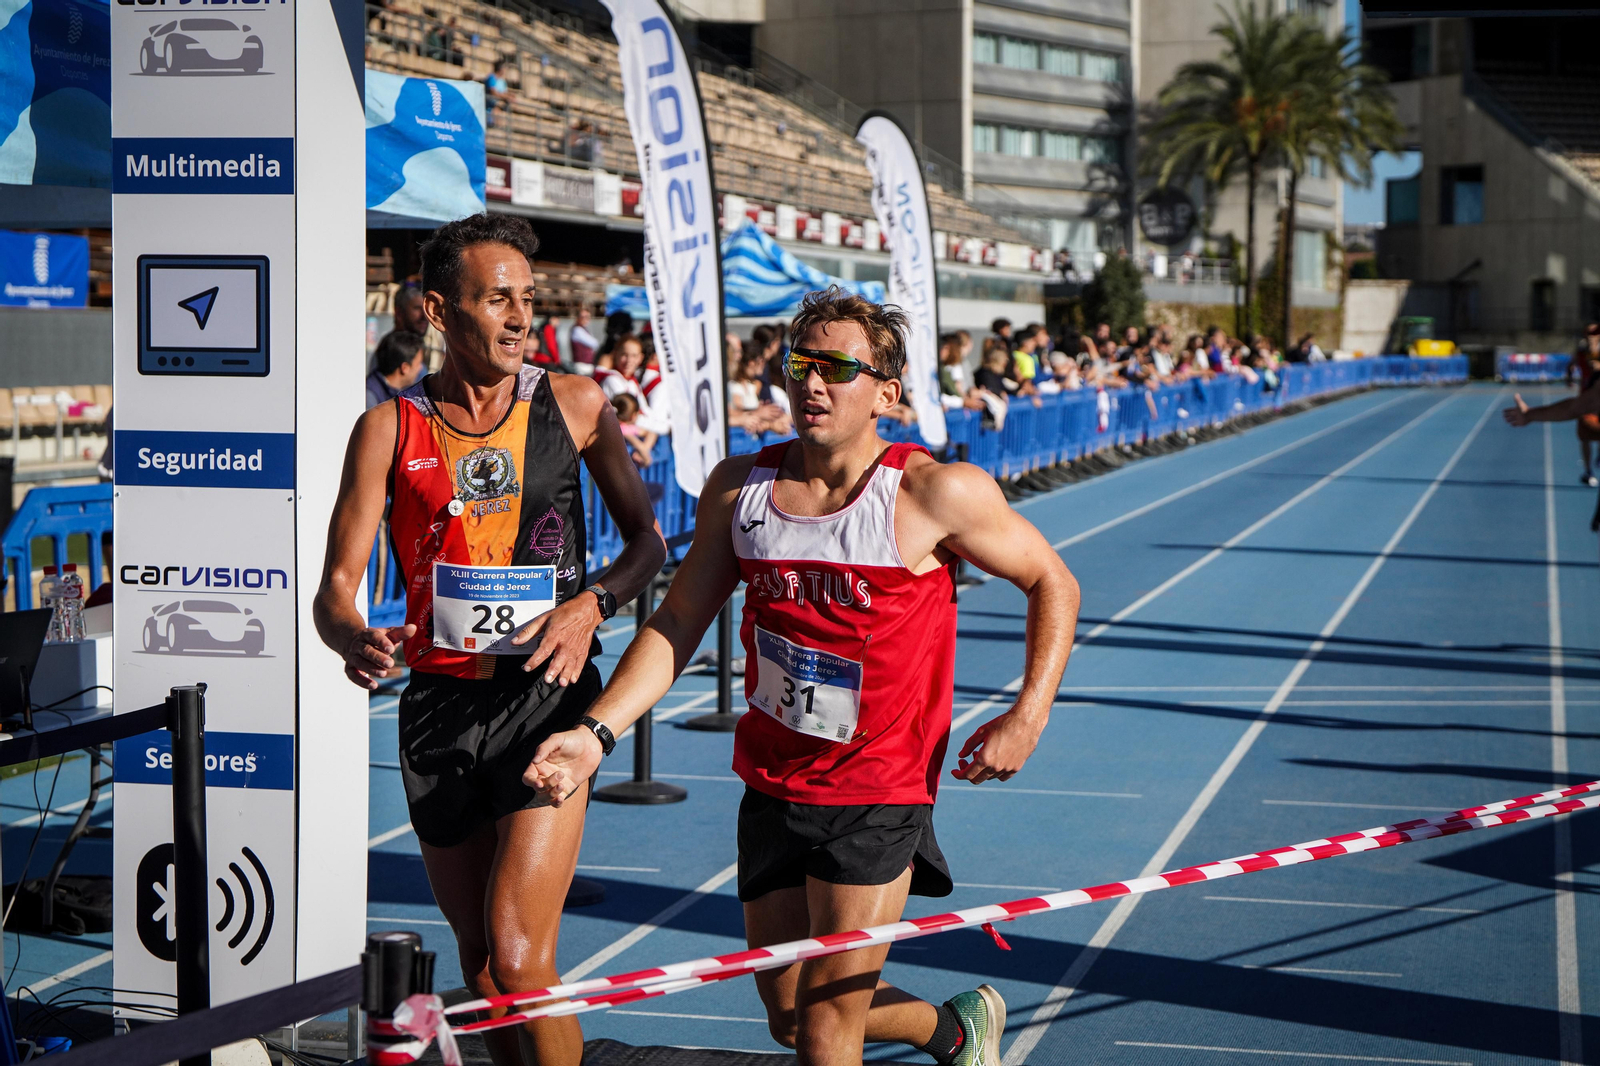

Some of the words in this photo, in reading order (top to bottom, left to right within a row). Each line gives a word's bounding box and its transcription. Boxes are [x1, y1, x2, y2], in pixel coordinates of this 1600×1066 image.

[126, 153, 281, 178] Multimedia
[138, 447, 263, 475] Seguridad
[472, 499, 511, 517] JEREZ
[120, 565, 288, 589] carvision
[450, 569, 470, 579] XLIII
[471, 571, 506, 580] Carrera
[507, 571, 543, 581] Popular
[459, 582, 491, 591] Ciudad
[493, 583, 505, 591] de
[506, 583, 531, 592] Jerez
[471, 604, 516, 635] 28
[777, 649, 798, 668] Ciudad
[798, 660, 811, 672] de
[812, 664, 837, 677] Jerez
[785, 643, 812, 661] Carrera
[813, 653, 850, 668] Popular
[780, 676, 816, 715] 31
[145, 747, 257, 772] Seores
